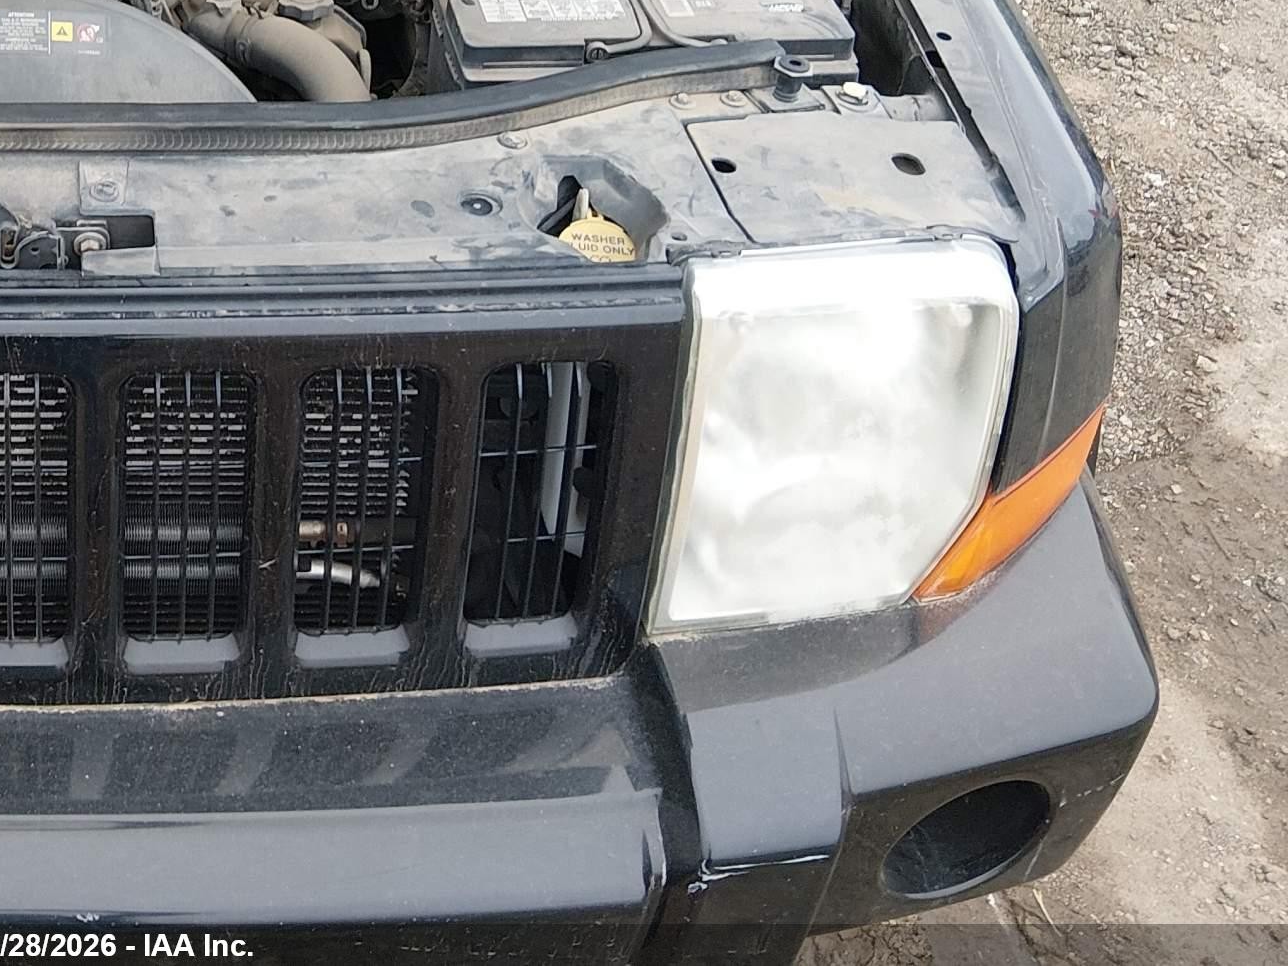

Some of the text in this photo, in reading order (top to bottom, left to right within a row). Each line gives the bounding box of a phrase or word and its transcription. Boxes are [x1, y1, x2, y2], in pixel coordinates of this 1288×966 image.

[572, 233, 625, 245] WASHER
[569, 242, 634, 256] UID ONLY
